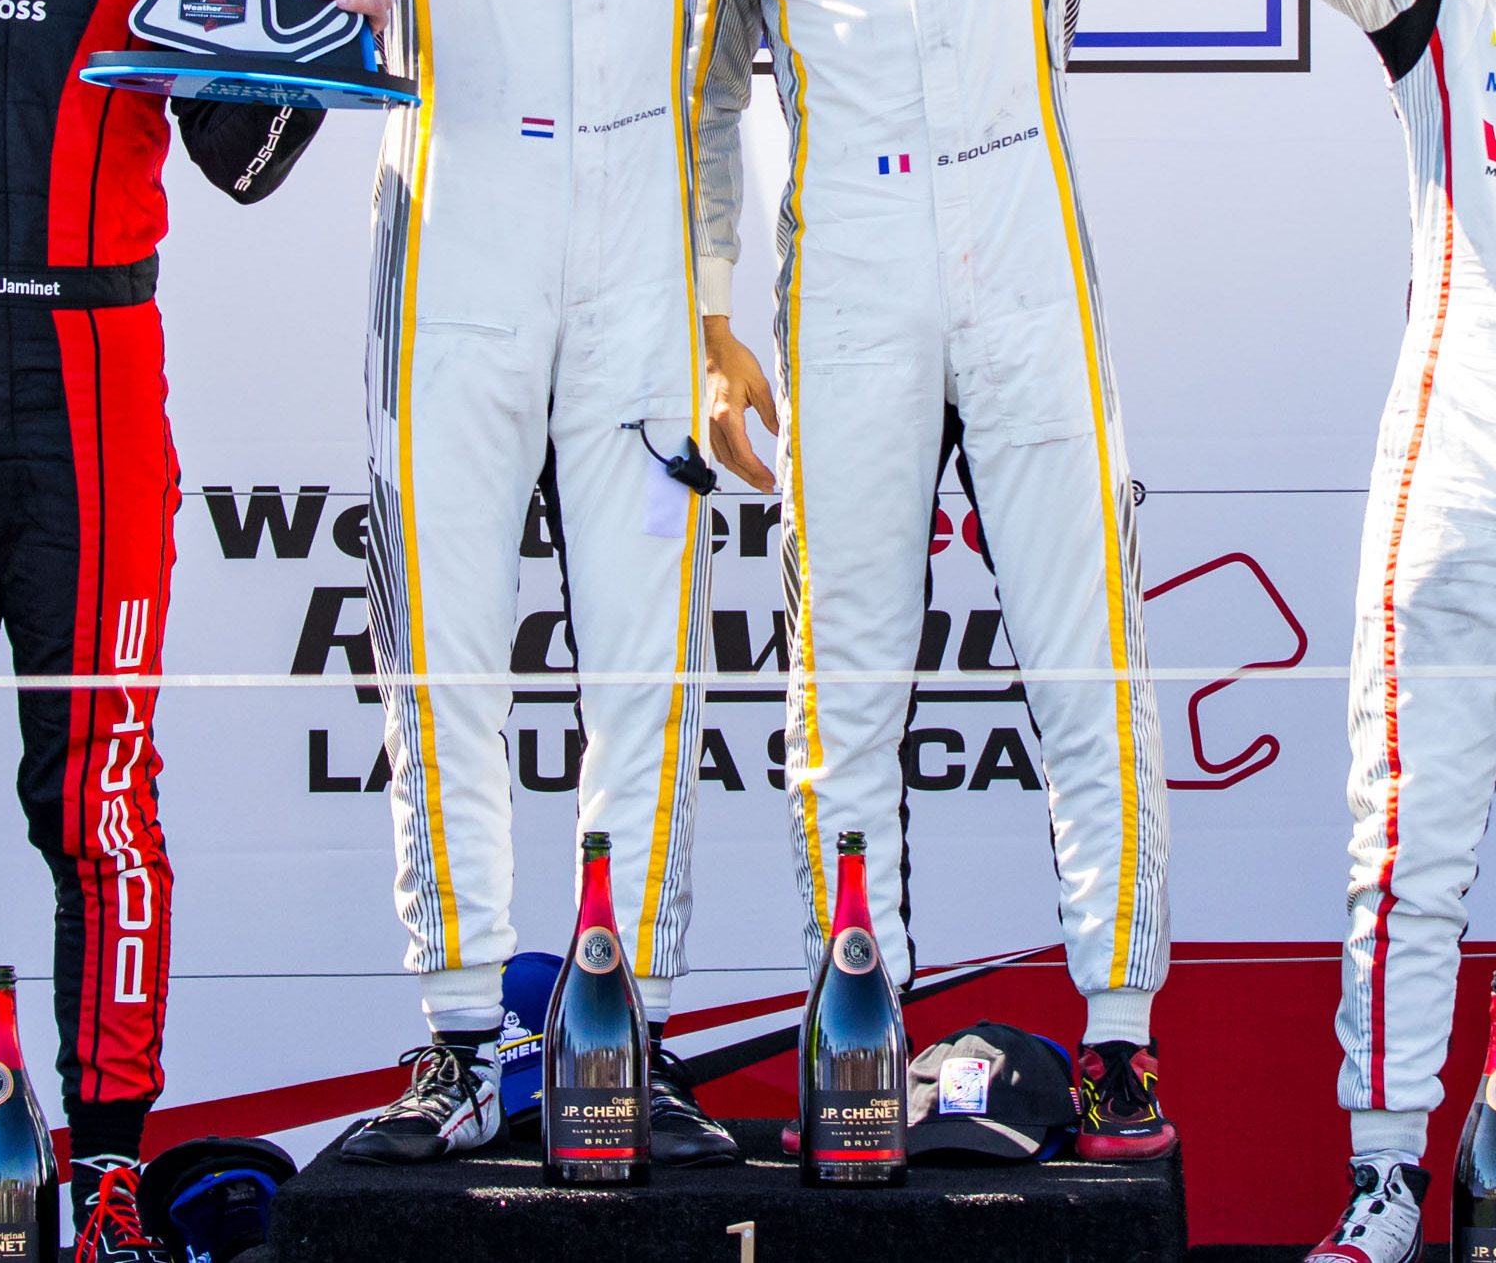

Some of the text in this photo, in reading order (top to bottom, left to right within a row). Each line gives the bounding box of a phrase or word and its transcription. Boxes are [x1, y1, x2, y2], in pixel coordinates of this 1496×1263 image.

[936, 126, 1039, 166] S. BOURDAIS
[0, 278, 61, 296] Jaminet
[98, 599, 153, 1004] PORSCHE
[561, 1106, 640, 1118] JP. CHENET
[820, 1106, 900, 1119] JP. CHENET
[726, 1220, 756, 1263] 1
[1471, 1246, 1494, 1258] JP.
